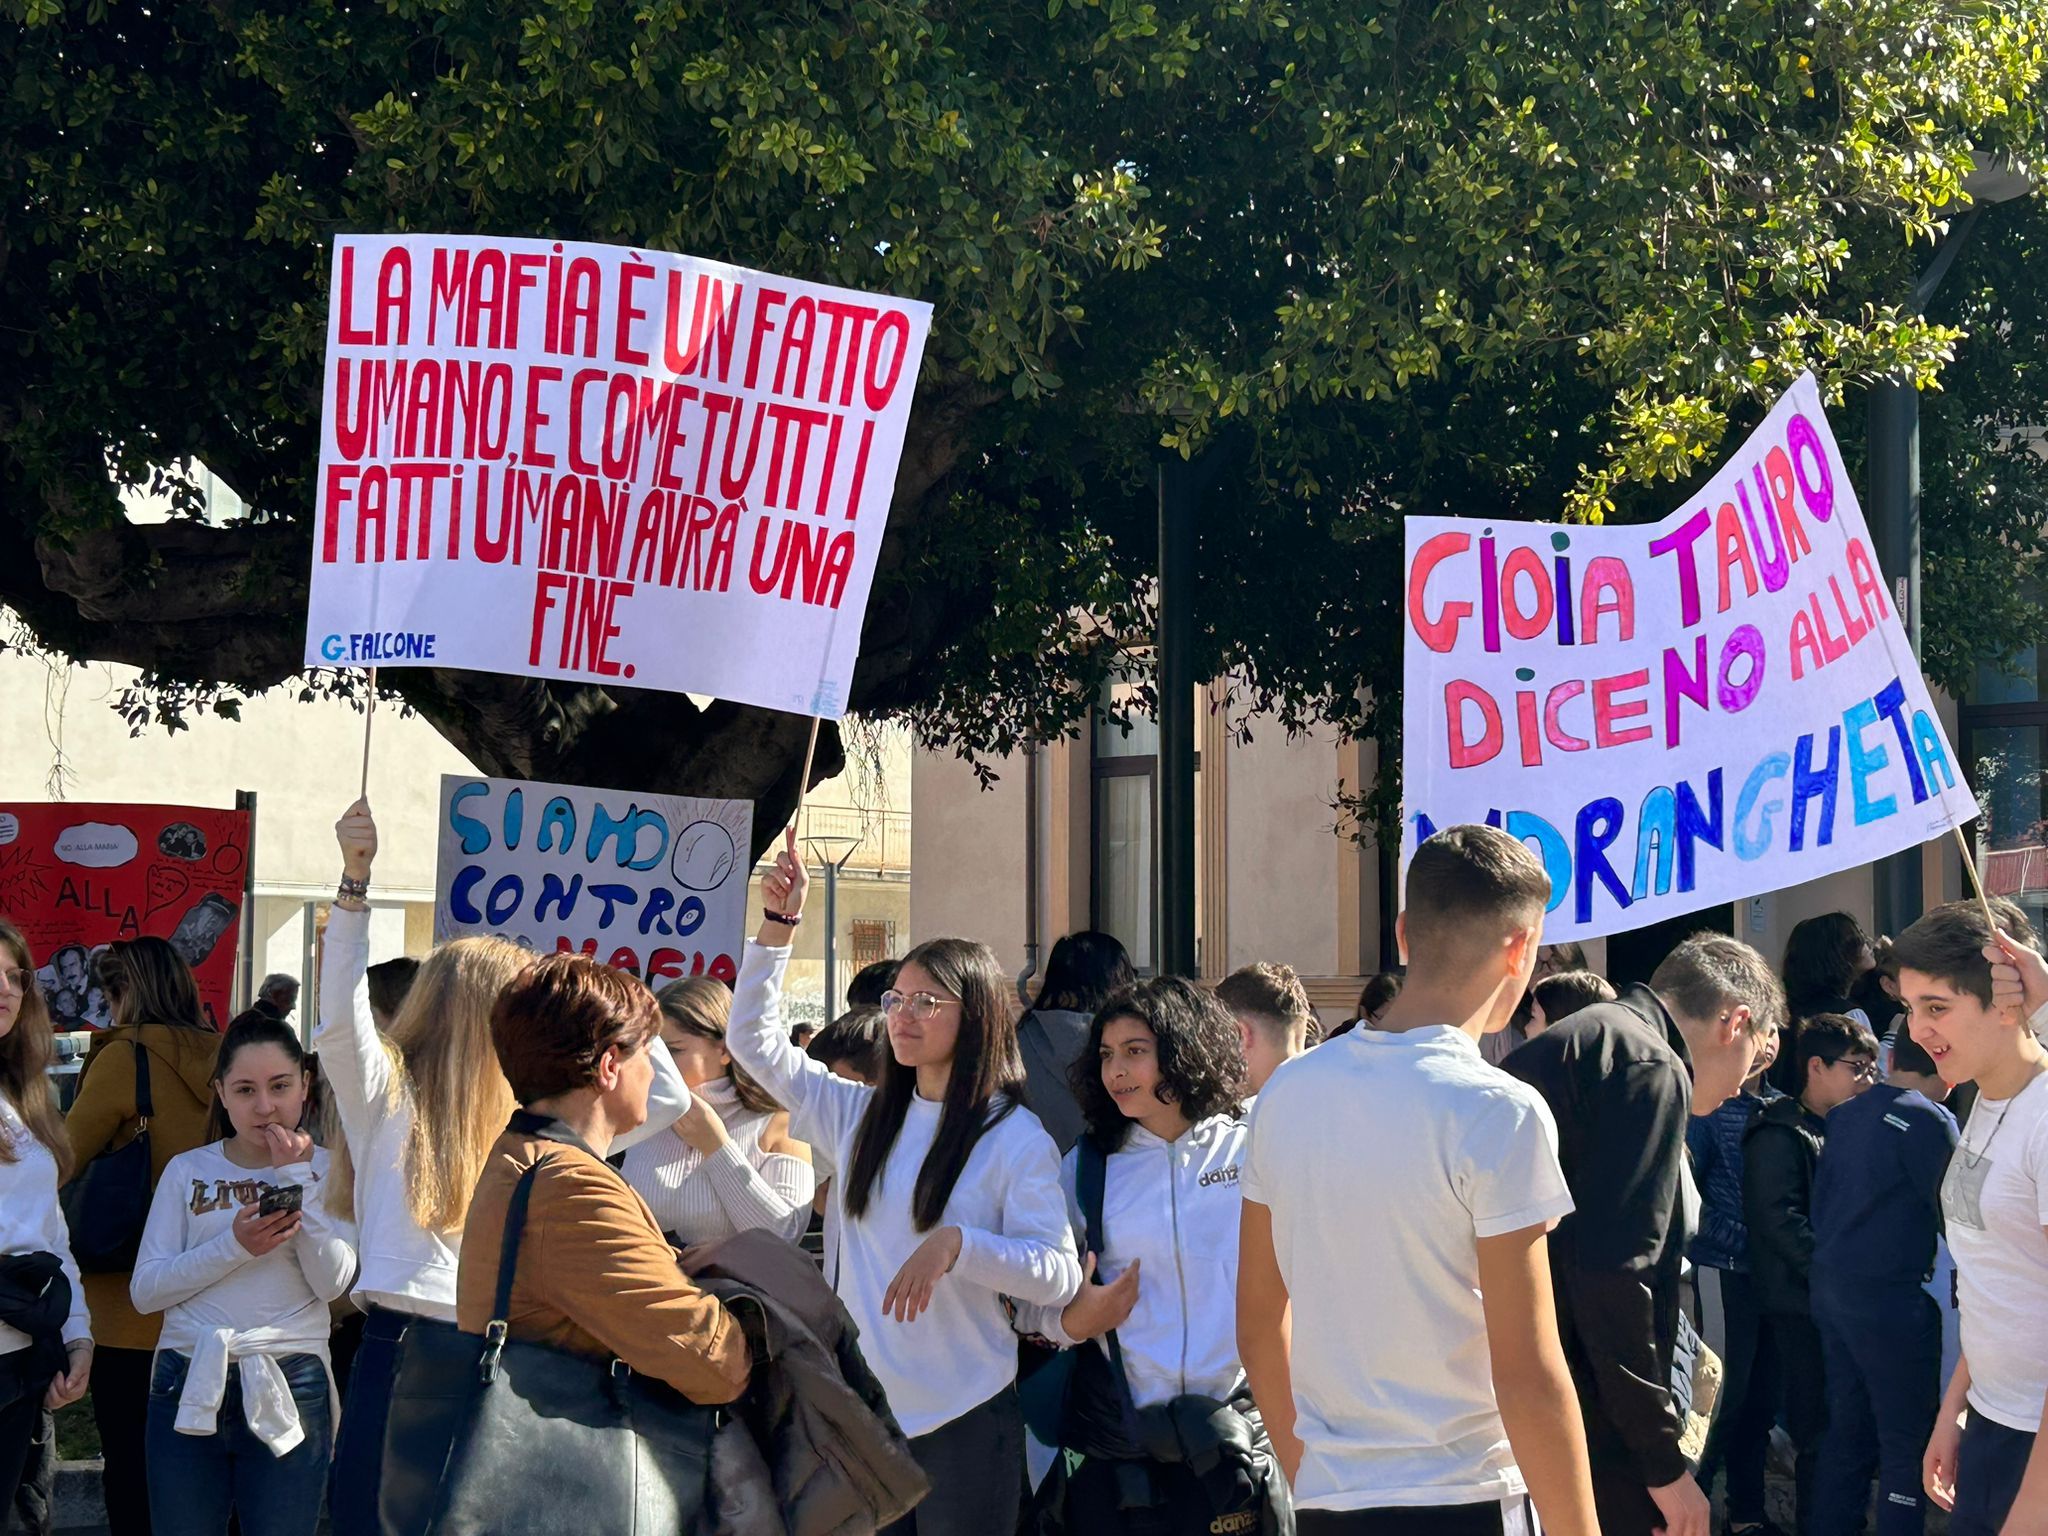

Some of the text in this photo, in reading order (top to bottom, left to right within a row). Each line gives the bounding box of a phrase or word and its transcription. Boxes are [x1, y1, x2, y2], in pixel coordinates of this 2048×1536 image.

[337, 246, 411, 347] LA
[615, 250, 655, 366] È
[664, 269, 743, 383] UN
[744, 287, 910, 411] FATTO
[520, 366, 564, 467] E
[568, 368, 699, 490] COME
[695, 390, 844, 517] TUTTI
[749, 515, 855, 610] UNA
[1649, 413, 1834, 628] TAURO
[529, 571, 636, 680] FINE.
[1663, 623, 1767, 750] NO
[1789, 537, 1891, 682] ALLA
[449, 782, 670, 871] SIAMO
[54, 876, 140, 937] ALLA
[450, 865, 706, 937] CONTRO
